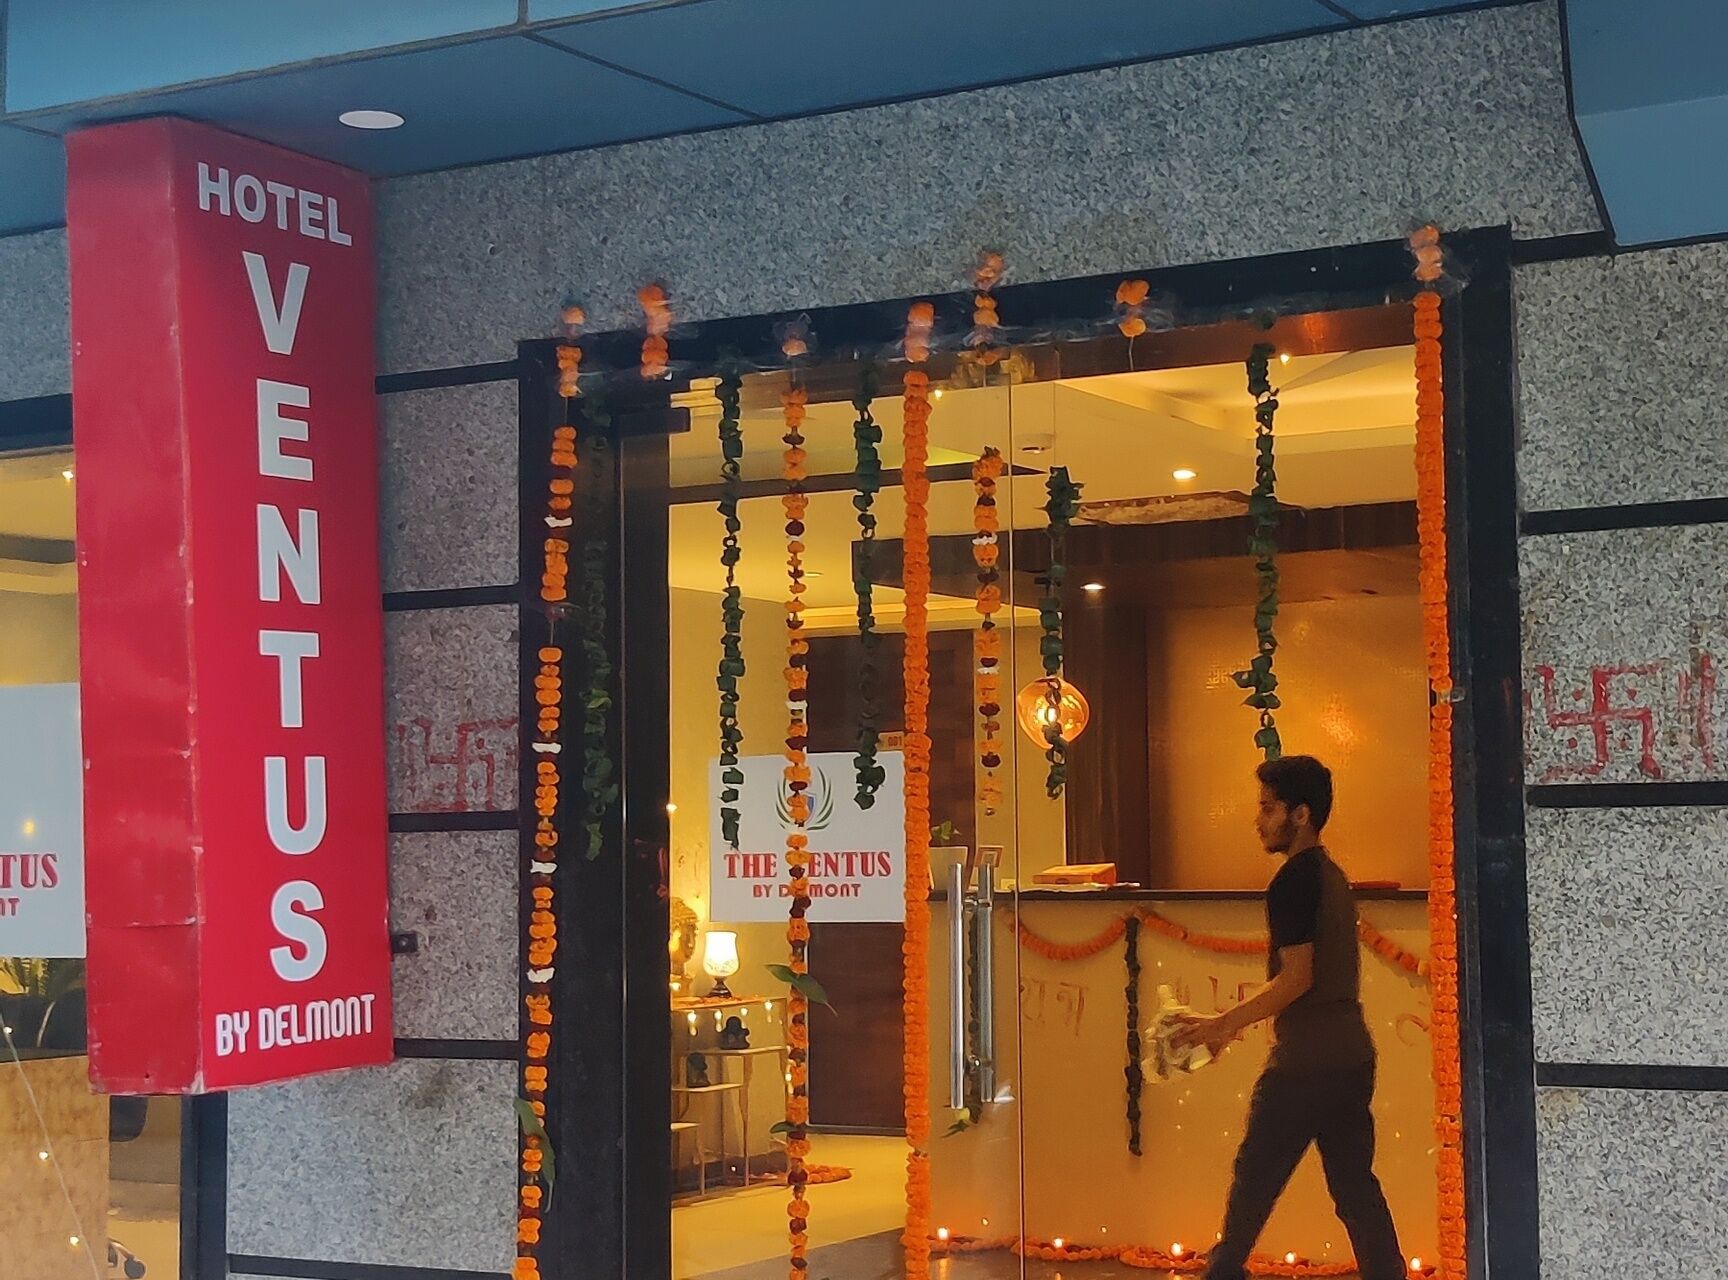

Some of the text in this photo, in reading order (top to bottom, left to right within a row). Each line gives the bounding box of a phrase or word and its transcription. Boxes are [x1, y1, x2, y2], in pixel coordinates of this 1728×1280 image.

[198, 162, 352, 247] HOTEL
[243, 251, 328, 983] VENTUS
[723, 851, 892, 879] THE ENTUS
[752, 883, 862, 898] BY DMONT
[216, 994, 375, 1056] BY DELMONT
